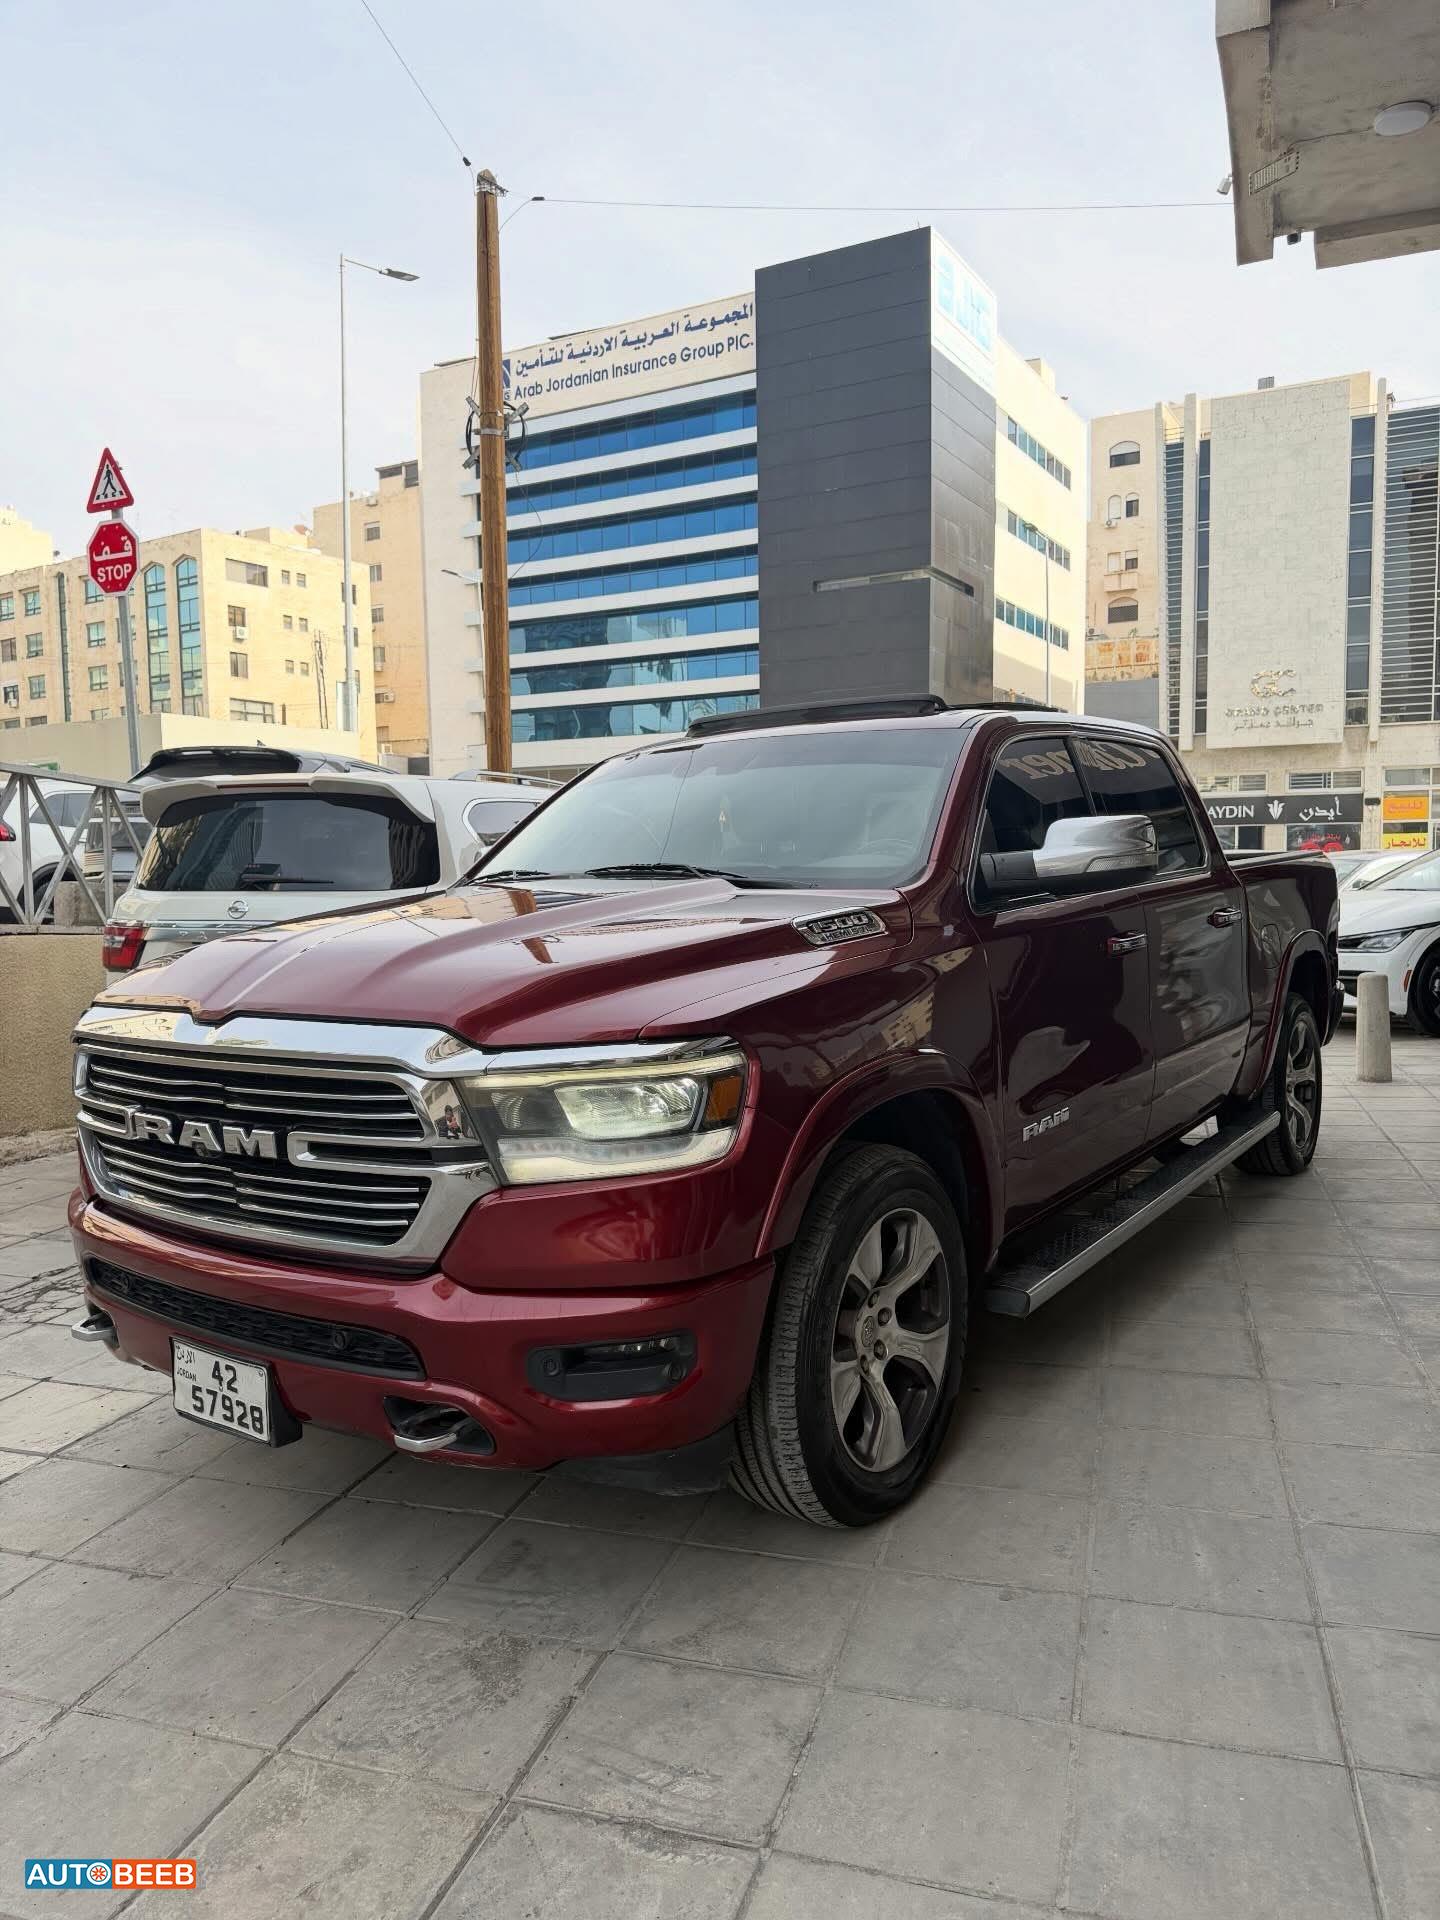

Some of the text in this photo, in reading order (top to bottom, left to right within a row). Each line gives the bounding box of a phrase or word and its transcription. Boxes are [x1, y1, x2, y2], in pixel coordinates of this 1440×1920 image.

[684, 303, 753, 332] المجموعة
[620, 322, 680, 350] العربية
[514, 381, 543, 400] Arab
[546, 368, 608, 393] Jordanian
[612, 353, 677, 378] Insurance
[680, 342, 724, 362] Group
[93, 535, 133, 562] قف
[97, 563, 132, 583] STOP
[1207, 805, 1255, 819] AYDIN
[1299, 796, 1343, 821] أيدن
[807, 914, 869, 933] 1500
[134, 1112, 278, 1160] RAM
[1022, 1107, 1070, 1142] RAM
[177, 1367, 197, 1382] JORDAN
[211, 1360, 239, 1393] 42
[191, 1384, 264, 1434] 57928
